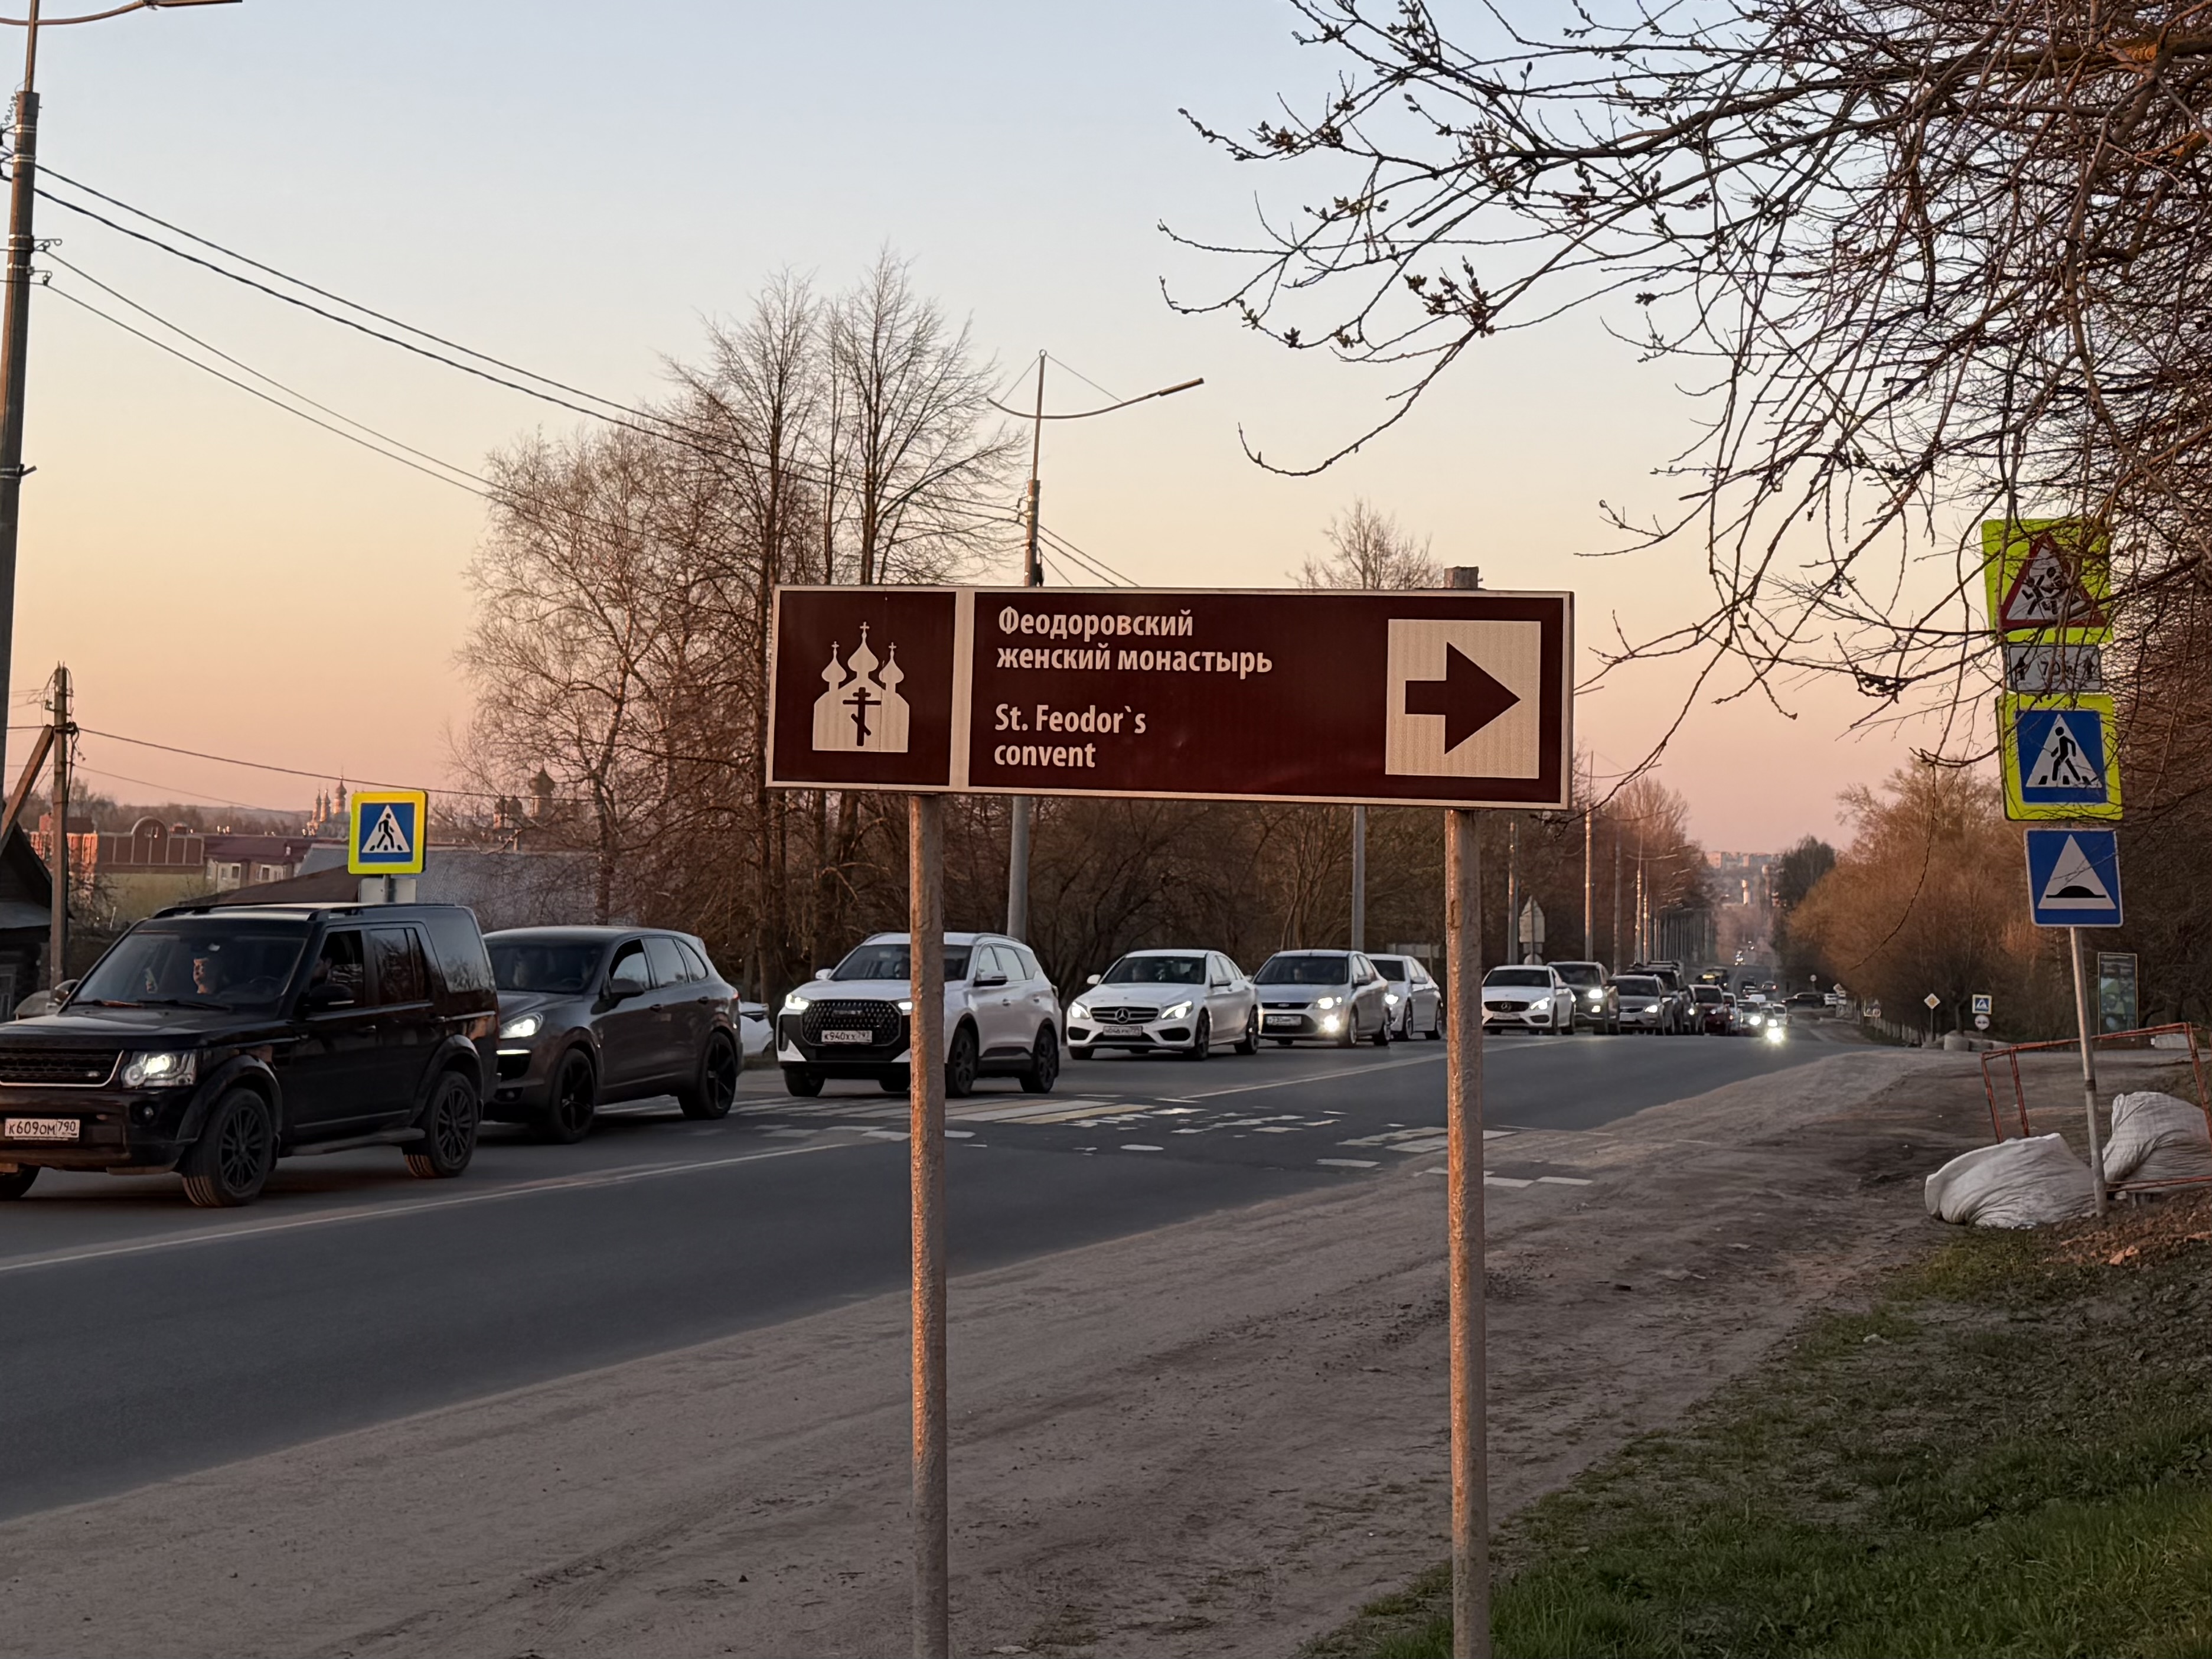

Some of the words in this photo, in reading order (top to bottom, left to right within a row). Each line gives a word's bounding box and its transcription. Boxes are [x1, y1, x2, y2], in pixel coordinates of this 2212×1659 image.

[999, 606, 1193, 642] Феодоровский
[997, 643, 1111, 670] женский
[1117, 651, 1273, 680] монастырь
[995, 703, 1029, 731] St.
[994, 742, 1096, 768] convent
